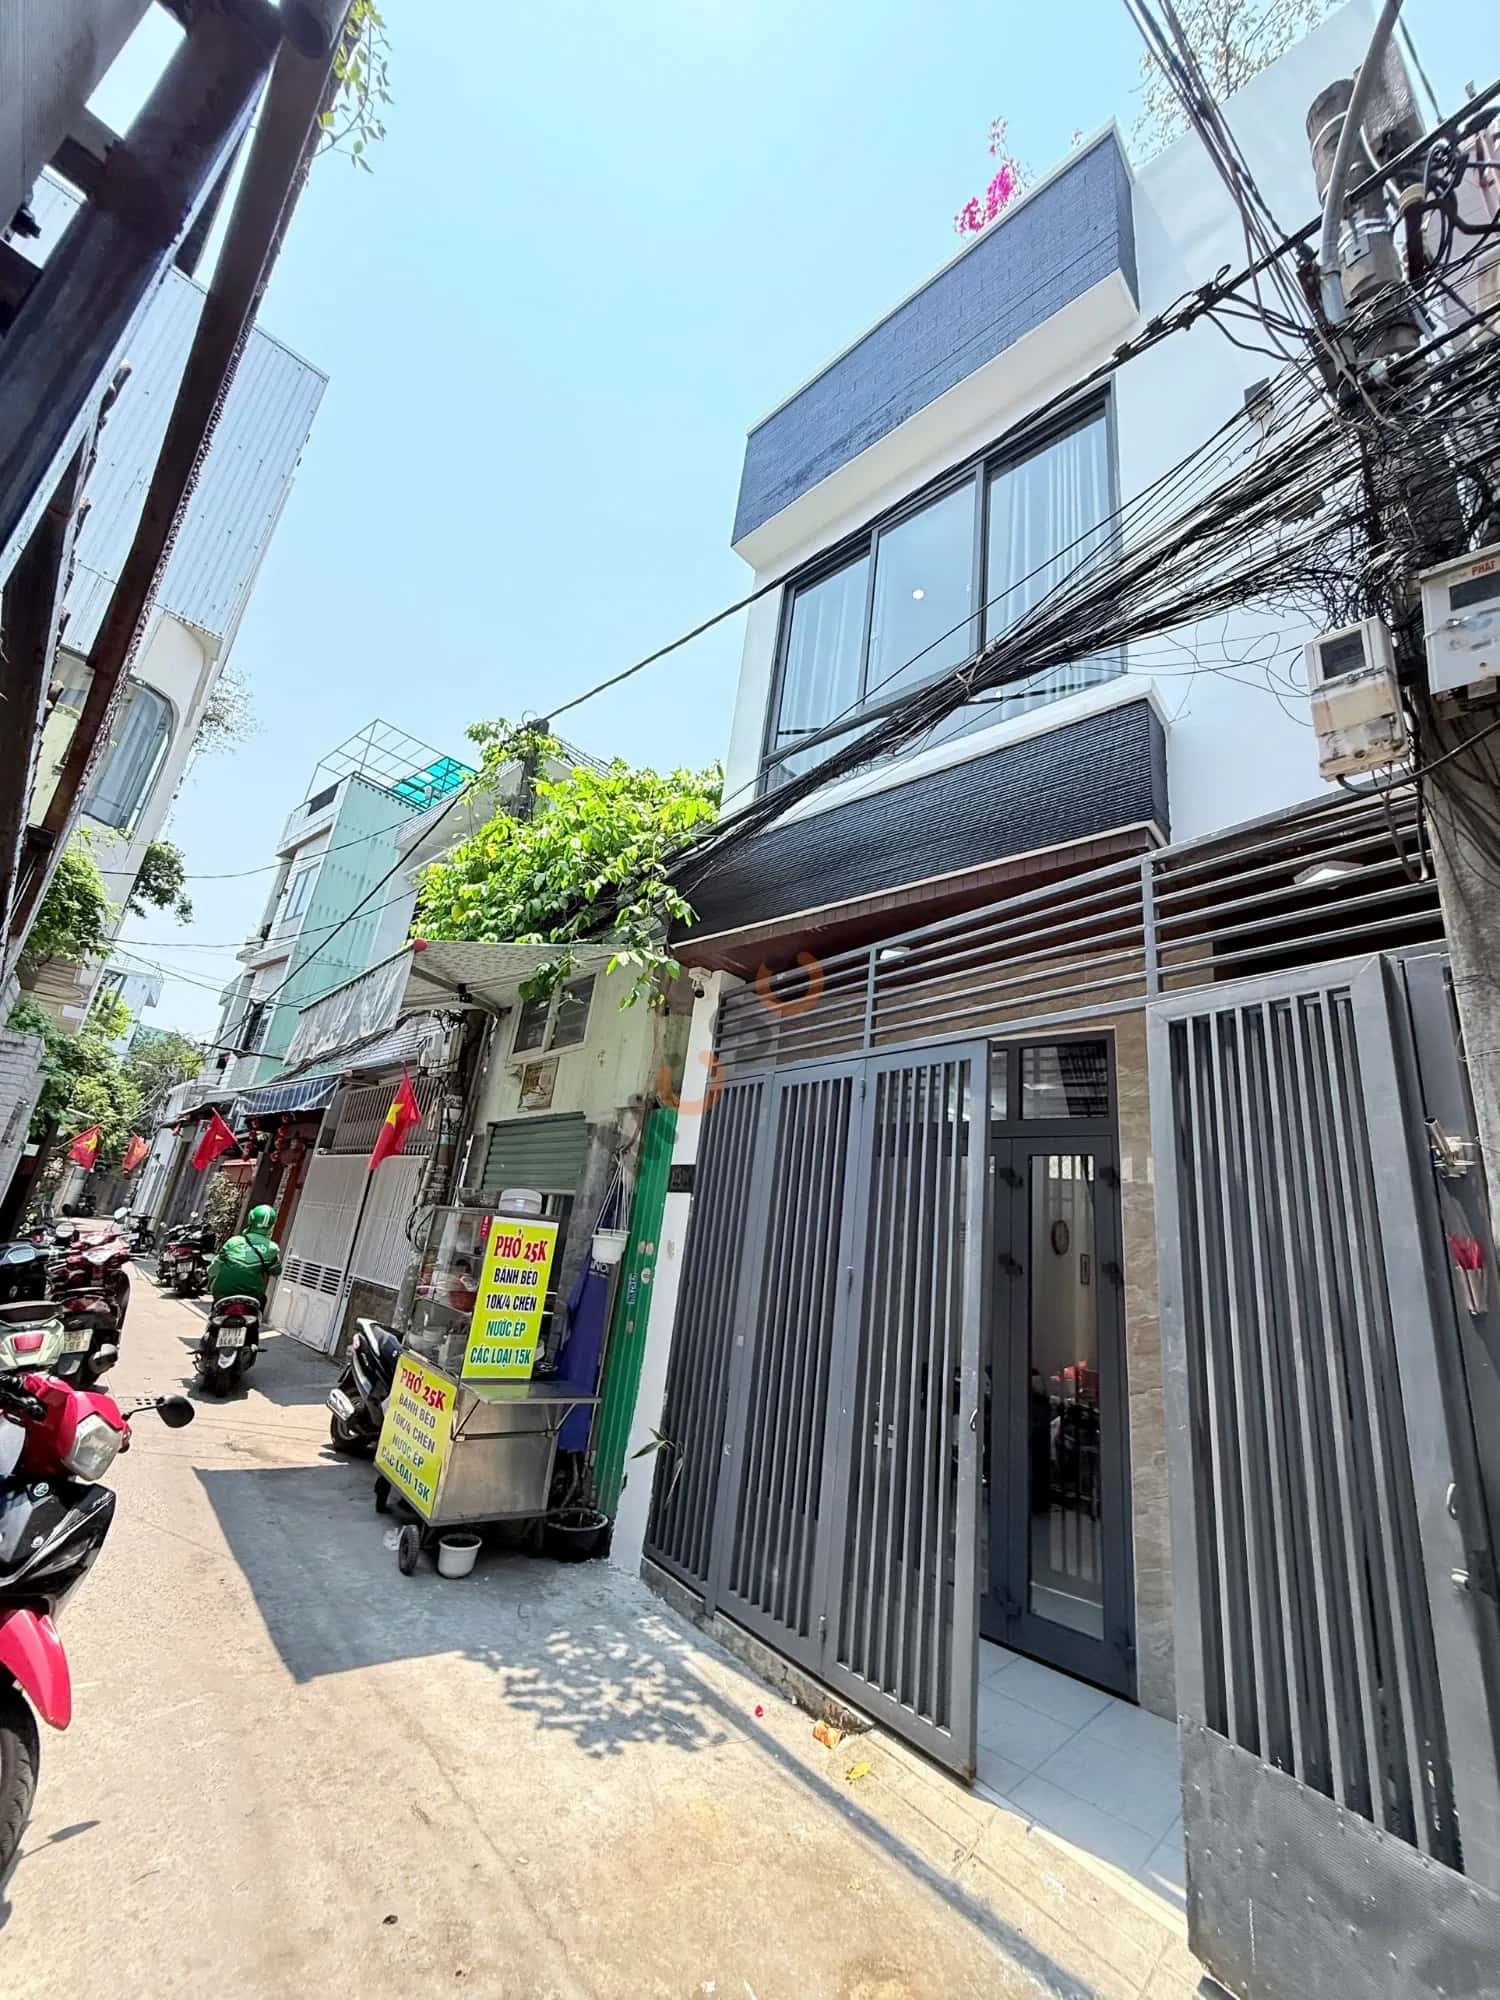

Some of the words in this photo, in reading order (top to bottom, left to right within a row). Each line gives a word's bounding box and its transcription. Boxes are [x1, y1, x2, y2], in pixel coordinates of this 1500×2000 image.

[494, 1229, 524, 1258] PHỞ
[523, 1240, 548, 1263] 25K
[493, 1265, 520, 1283] BÁNH
[486, 1294, 510, 1310] 10K/4
[512, 1293, 538, 1311] CHÉN
[486, 1318, 512, 1336] NƯỚC
[513, 1319, 526, 1337] ÉP
[470, 1344, 490, 1363] CÁC
[491, 1348, 513, 1367] LOẠI
[515, 1349, 531, 1364] 15K
[399, 1367, 425, 1393] PHỞ
[422, 1385, 447, 1412] 25K
[414, 1478, 430, 1502] 15K
